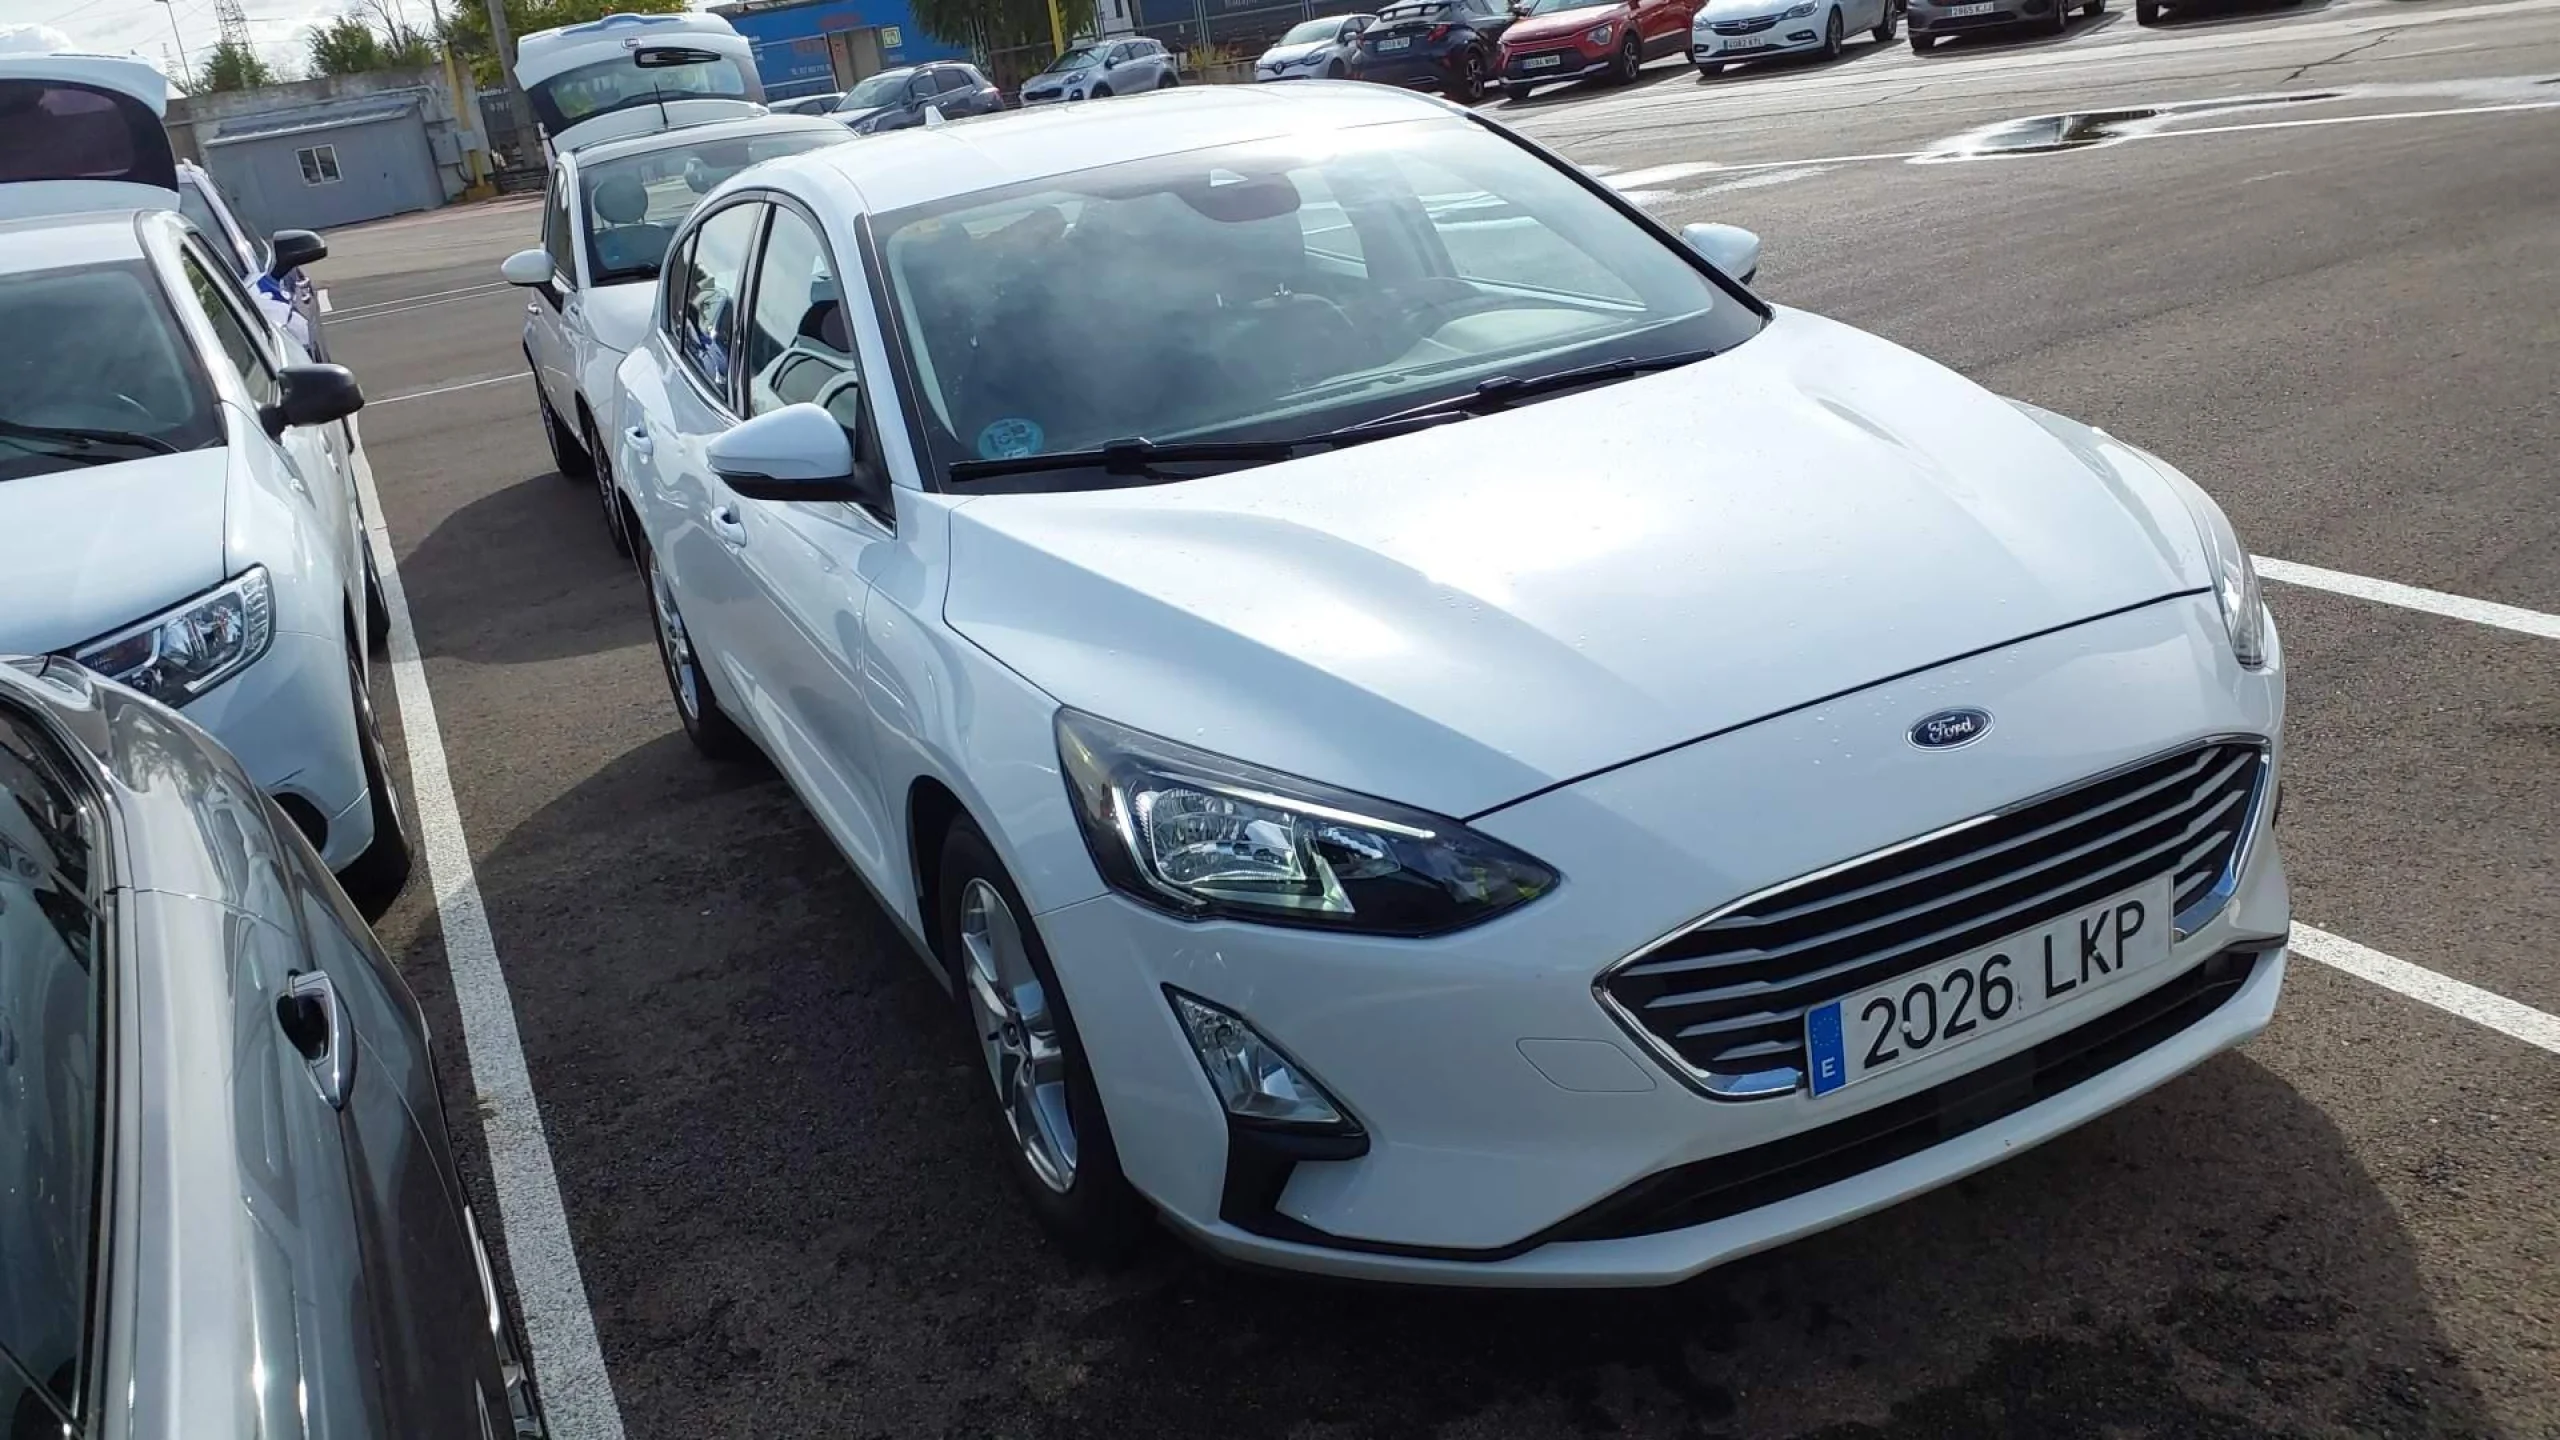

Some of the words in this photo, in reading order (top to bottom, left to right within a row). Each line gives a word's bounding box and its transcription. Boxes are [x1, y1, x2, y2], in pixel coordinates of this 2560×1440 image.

[1928, 716, 1975, 743] Ford
[1820, 1057, 1836, 1079] E
[1861, 954, 2013, 1070] 2026
[2044, 900, 2145, 999] LKP
